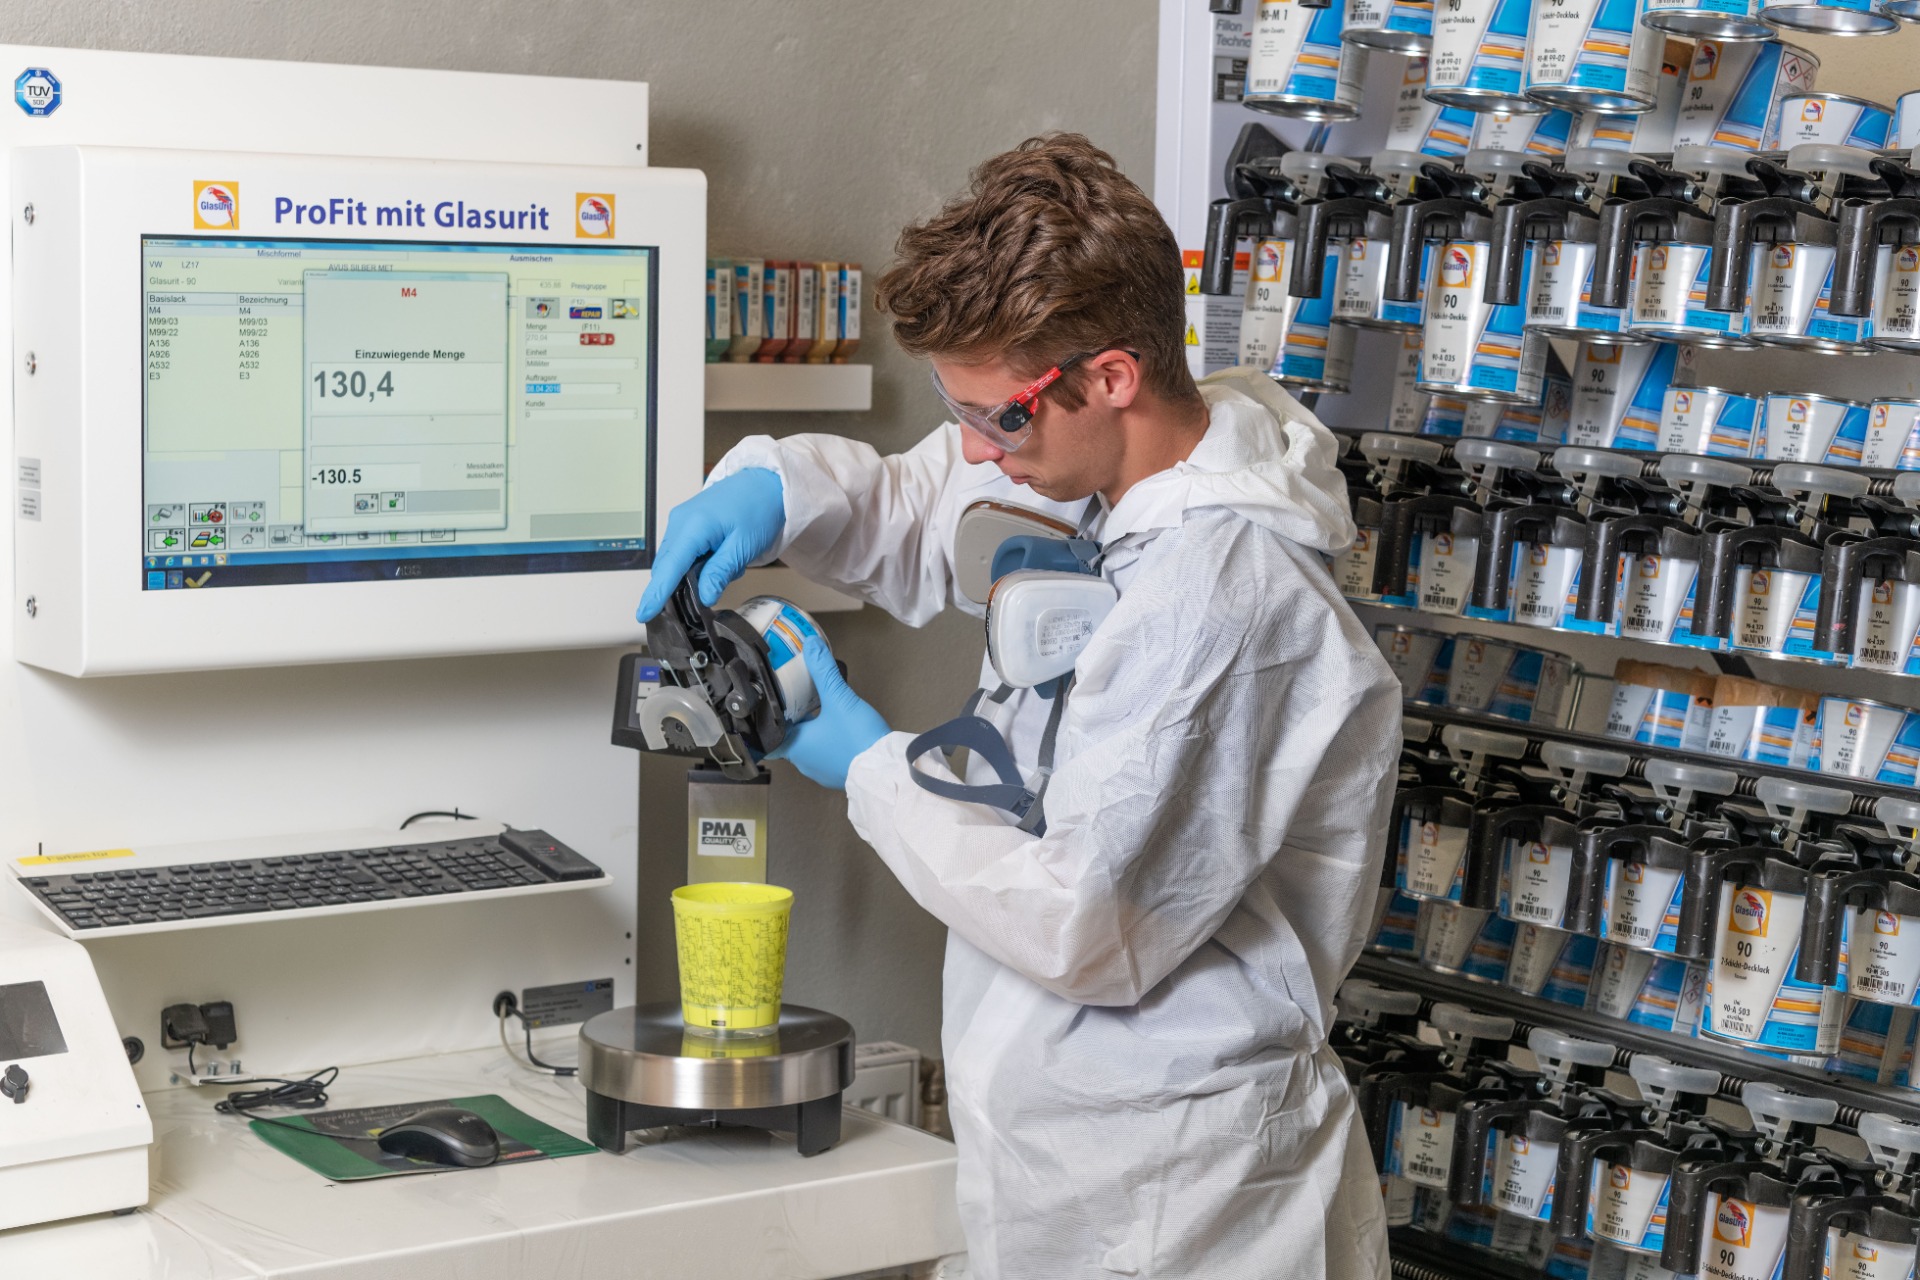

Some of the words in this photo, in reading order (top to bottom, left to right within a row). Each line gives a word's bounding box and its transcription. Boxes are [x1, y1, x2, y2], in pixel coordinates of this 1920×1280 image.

[1448, 0, 1461, 12] 90
[1261, 9, 1280, 21] 90-M
[1216, 19, 1242, 32] Fillon
[1691, 86, 1703, 100] 90
[1805, 124, 1813, 132] 90
[201, 201, 233, 211] Glasurit
[275, 197, 367, 226] ProFit
[376, 200, 426, 227] mit
[434, 201, 549, 231] Glasurit
[582, 211, 609, 221] Glasurit
[257, 250, 301, 258] Mischformel
[509, 255, 553, 263] Ausmischen
[149, 261, 163, 269] VW
[181, 261, 199, 269] LZ17
[328, 264, 349, 272] AVUS
[350, 264, 377, 272] SILBER
[378, 264, 394, 272] MET
[1442, 261, 1469, 272] Glasurit
[149, 277, 180, 286] Glasurit
[184, 278, 197, 286] 90
[401, 288, 418, 298] M4
[1257, 288, 1270, 301] 90
[149, 295, 187, 303] Basislack
[239, 296, 288, 305] Bezeichnung
[1443, 294, 1457, 309] 90
[149, 307, 161, 315] M4
[239, 307, 251, 315] M4
[149, 318, 179, 326] M99/03
[239, 318, 268, 326] M99/03
[526, 323, 547, 331] Menge
[149, 329, 179, 337] M99/22
[239, 329, 268, 337] M99/22
[149, 340, 170, 348] A136
[239, 340, 260, 348] A136
[149, 351, 170, 359] A926
[239, 351, 260, 359] A926
[355, 350, 430, 361] Einzuwiegende
[433, 350, 466, 361] Menge
[149, 361, 170, 370] A532
[239, 361, 260, 370] A532
[149, 372, 161, 380] E3
[239, 372, 250, 380] E3
[1591, 368, 1605, 382] 90
[312, 370, 395, 402] 130,4
[1792, 423, 1800, 431] 90
[311, 468, 362, 485] -130.5
[1753, 598, 1762, 606] 90
[1875, 610, 1883, 619] 90
[1849, 728, 1857, 736] 90
[702, 821, 747, 837] PMA
[1533, 869, 1541, 877] 90
[1627, 889, 1635, 897] 90
[1735, 906, 1764, 918] Glasurit
[1737, 940, 1753, 958] 90
[1879, 941, 1888, 950] 90
[1721, 956, 1770, 975] 2-Schicht-Decklack
[1723, 1003, 1737, 1014] 90-A
[1738, 1006, 1750, 1016] 503
[1424, 1132, 1432, 1140] 90
[1513, 1159, 1521, 1167] 90
[1613, 1190, 1622, 1199] 90
[1719, 1213, 1747, 1229] Glasurit
[1720, 1249, 1735, 1267] 90
[1858, 1262, 1867, 1271] 90
